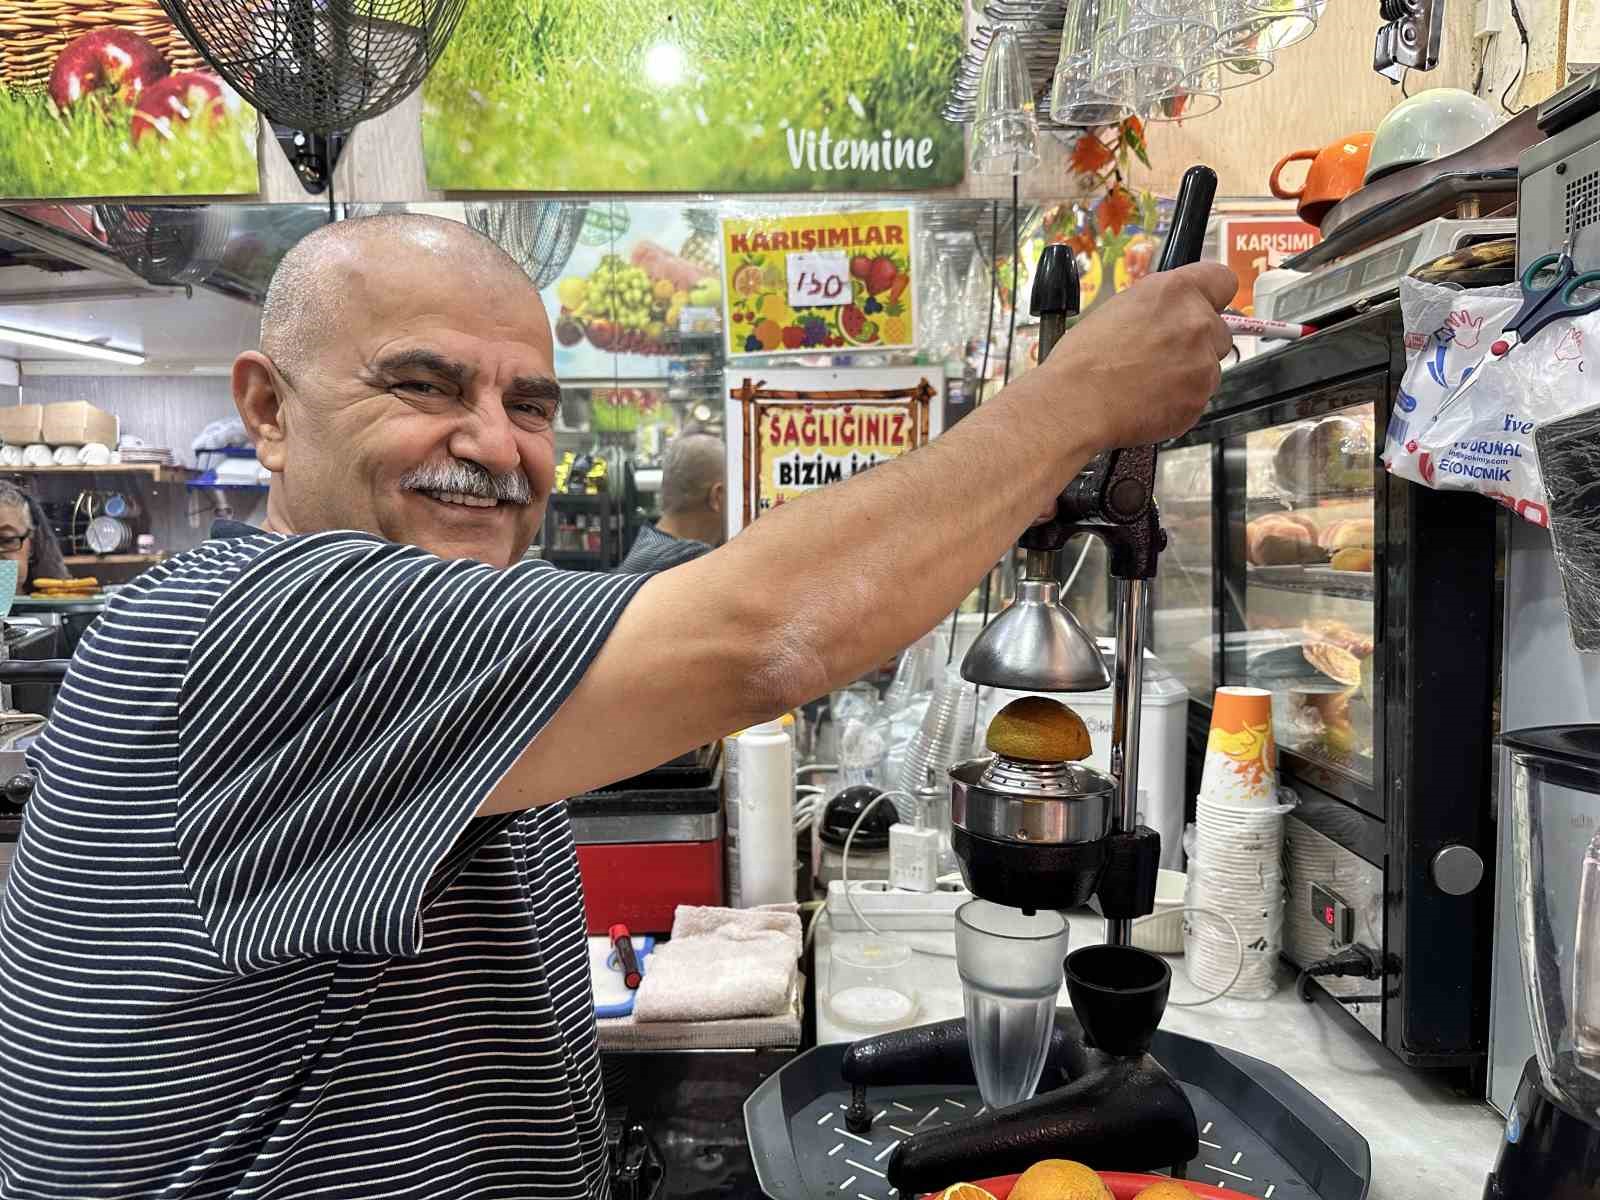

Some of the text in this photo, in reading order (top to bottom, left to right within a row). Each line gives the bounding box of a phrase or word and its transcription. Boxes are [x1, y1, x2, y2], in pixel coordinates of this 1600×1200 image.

[786, 127, 934, 172] Vitemine
[730, 225, 904, 253] KARIŞIMLAR
[769, 403, 905, 446] SAĞLIĞINIZ
[779, 453, 842, 486] BİZİM
